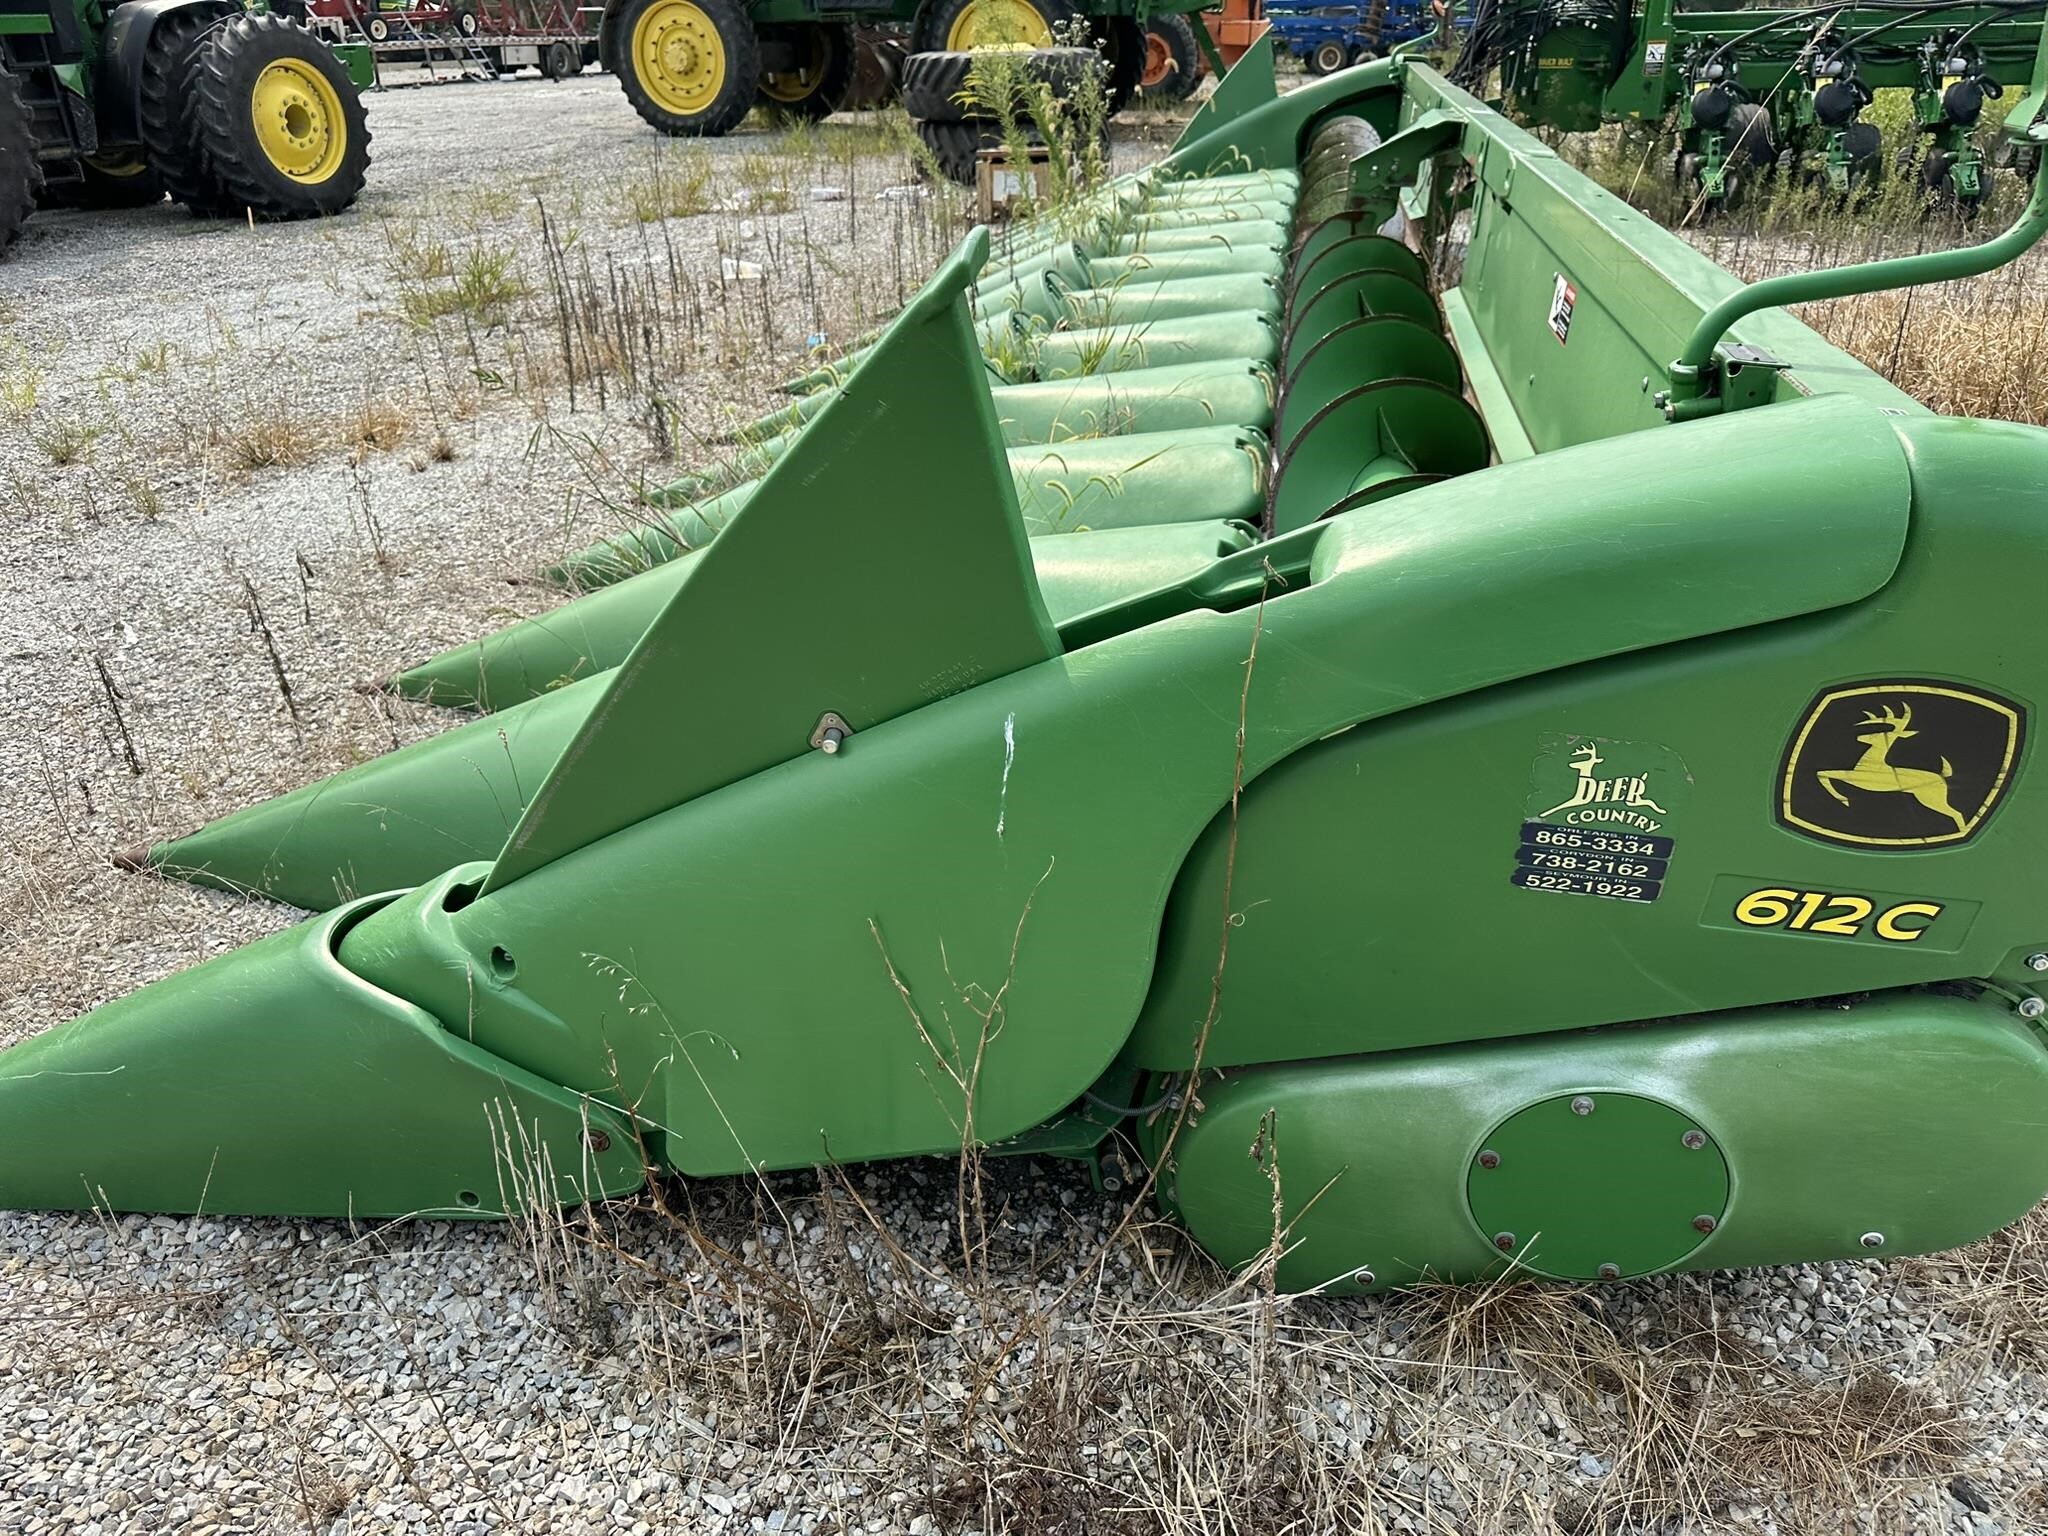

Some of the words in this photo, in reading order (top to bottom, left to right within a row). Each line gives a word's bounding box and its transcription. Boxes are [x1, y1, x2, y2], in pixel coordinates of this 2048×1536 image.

[1576, 776, 1646, 803] DEER
[1566, 808, 1661, 833] COUNTRY
[1535, 830, 1654, 856] 865-3334
[1531, 852, 1649, 878] 738-2162
[1525, 873, 1642, 899] 522-1922
[1735, 888, 1943, 941] 612C
